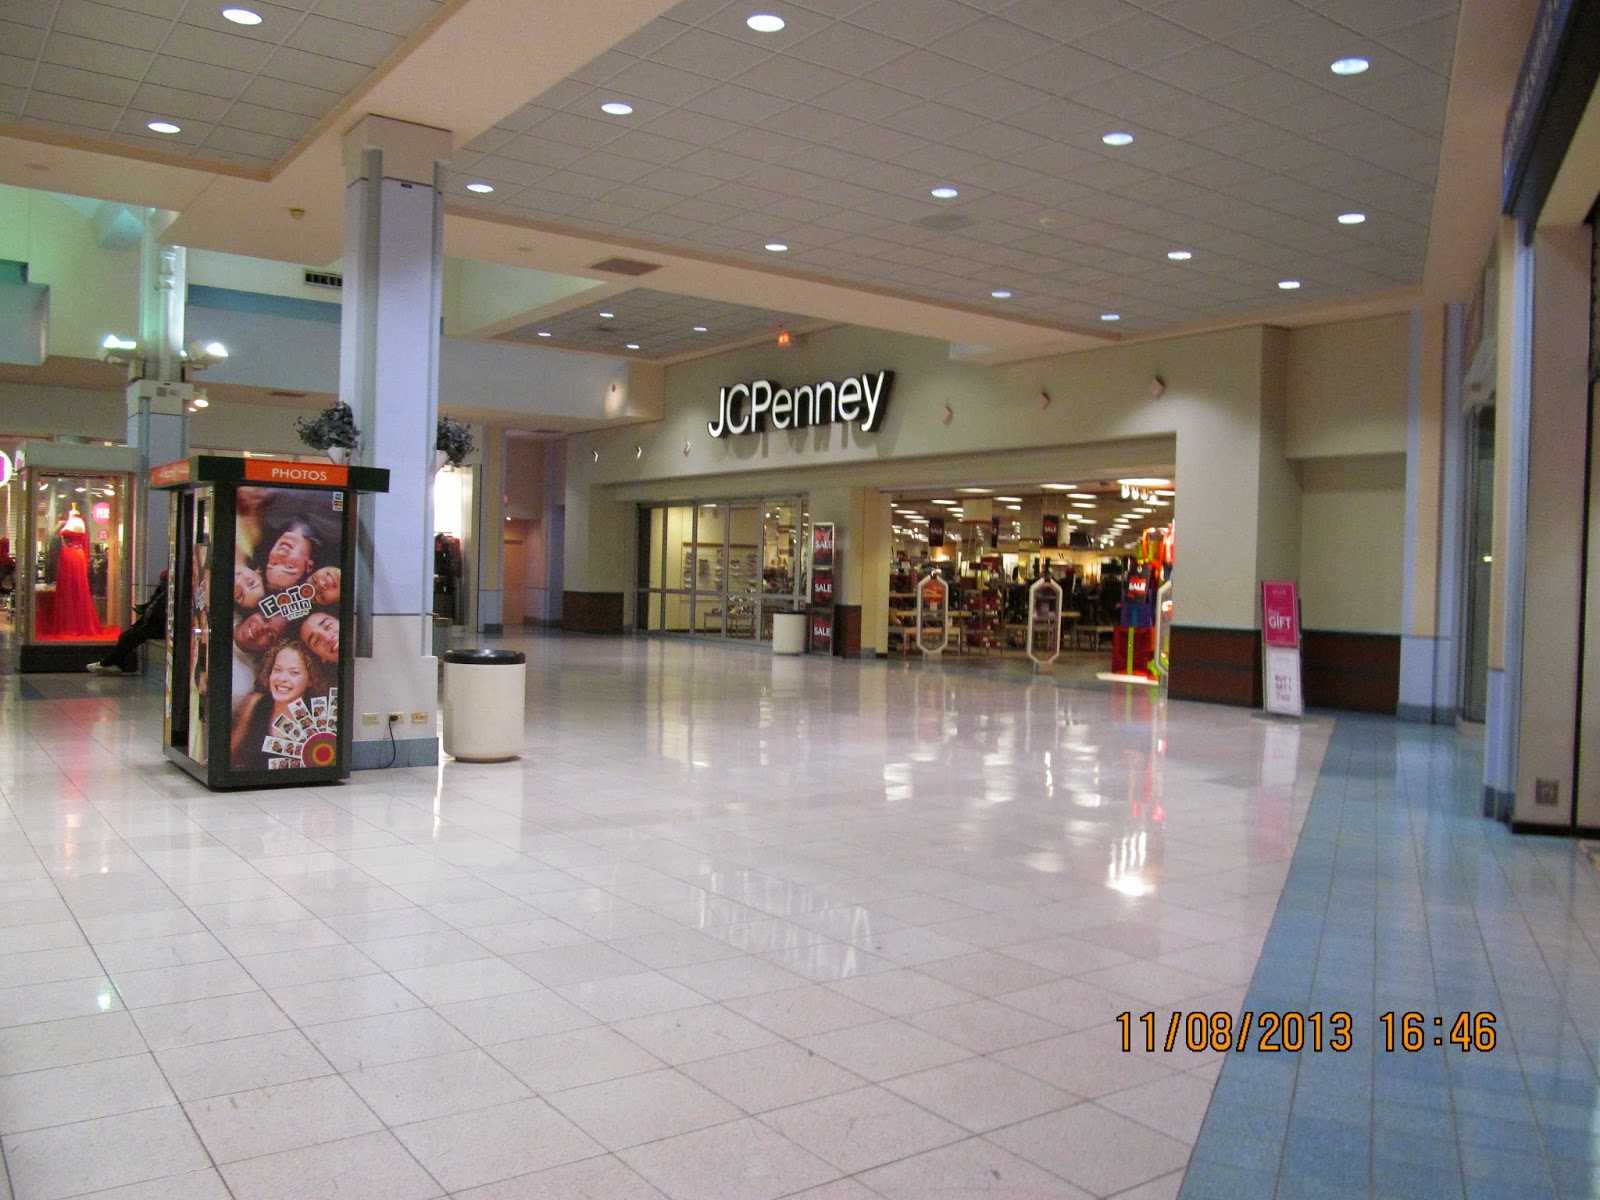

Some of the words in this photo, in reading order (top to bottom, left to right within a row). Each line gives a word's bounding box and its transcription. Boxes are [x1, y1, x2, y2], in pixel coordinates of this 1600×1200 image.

[707, 370, 894, 439] JCPenney
[271, 467, 328, 482] PHOTOS
[815, 540, 833, 550] SALE
[814, 583, 832, 593] SALE
[1128, 582, 1147, 592] SALE
[259, 583, 316, 618] FOTO
[280, 600, 311, 617] fun
[1269, 616, 1291, 629] GIFT
[813, 626, 831, 637] SALE
